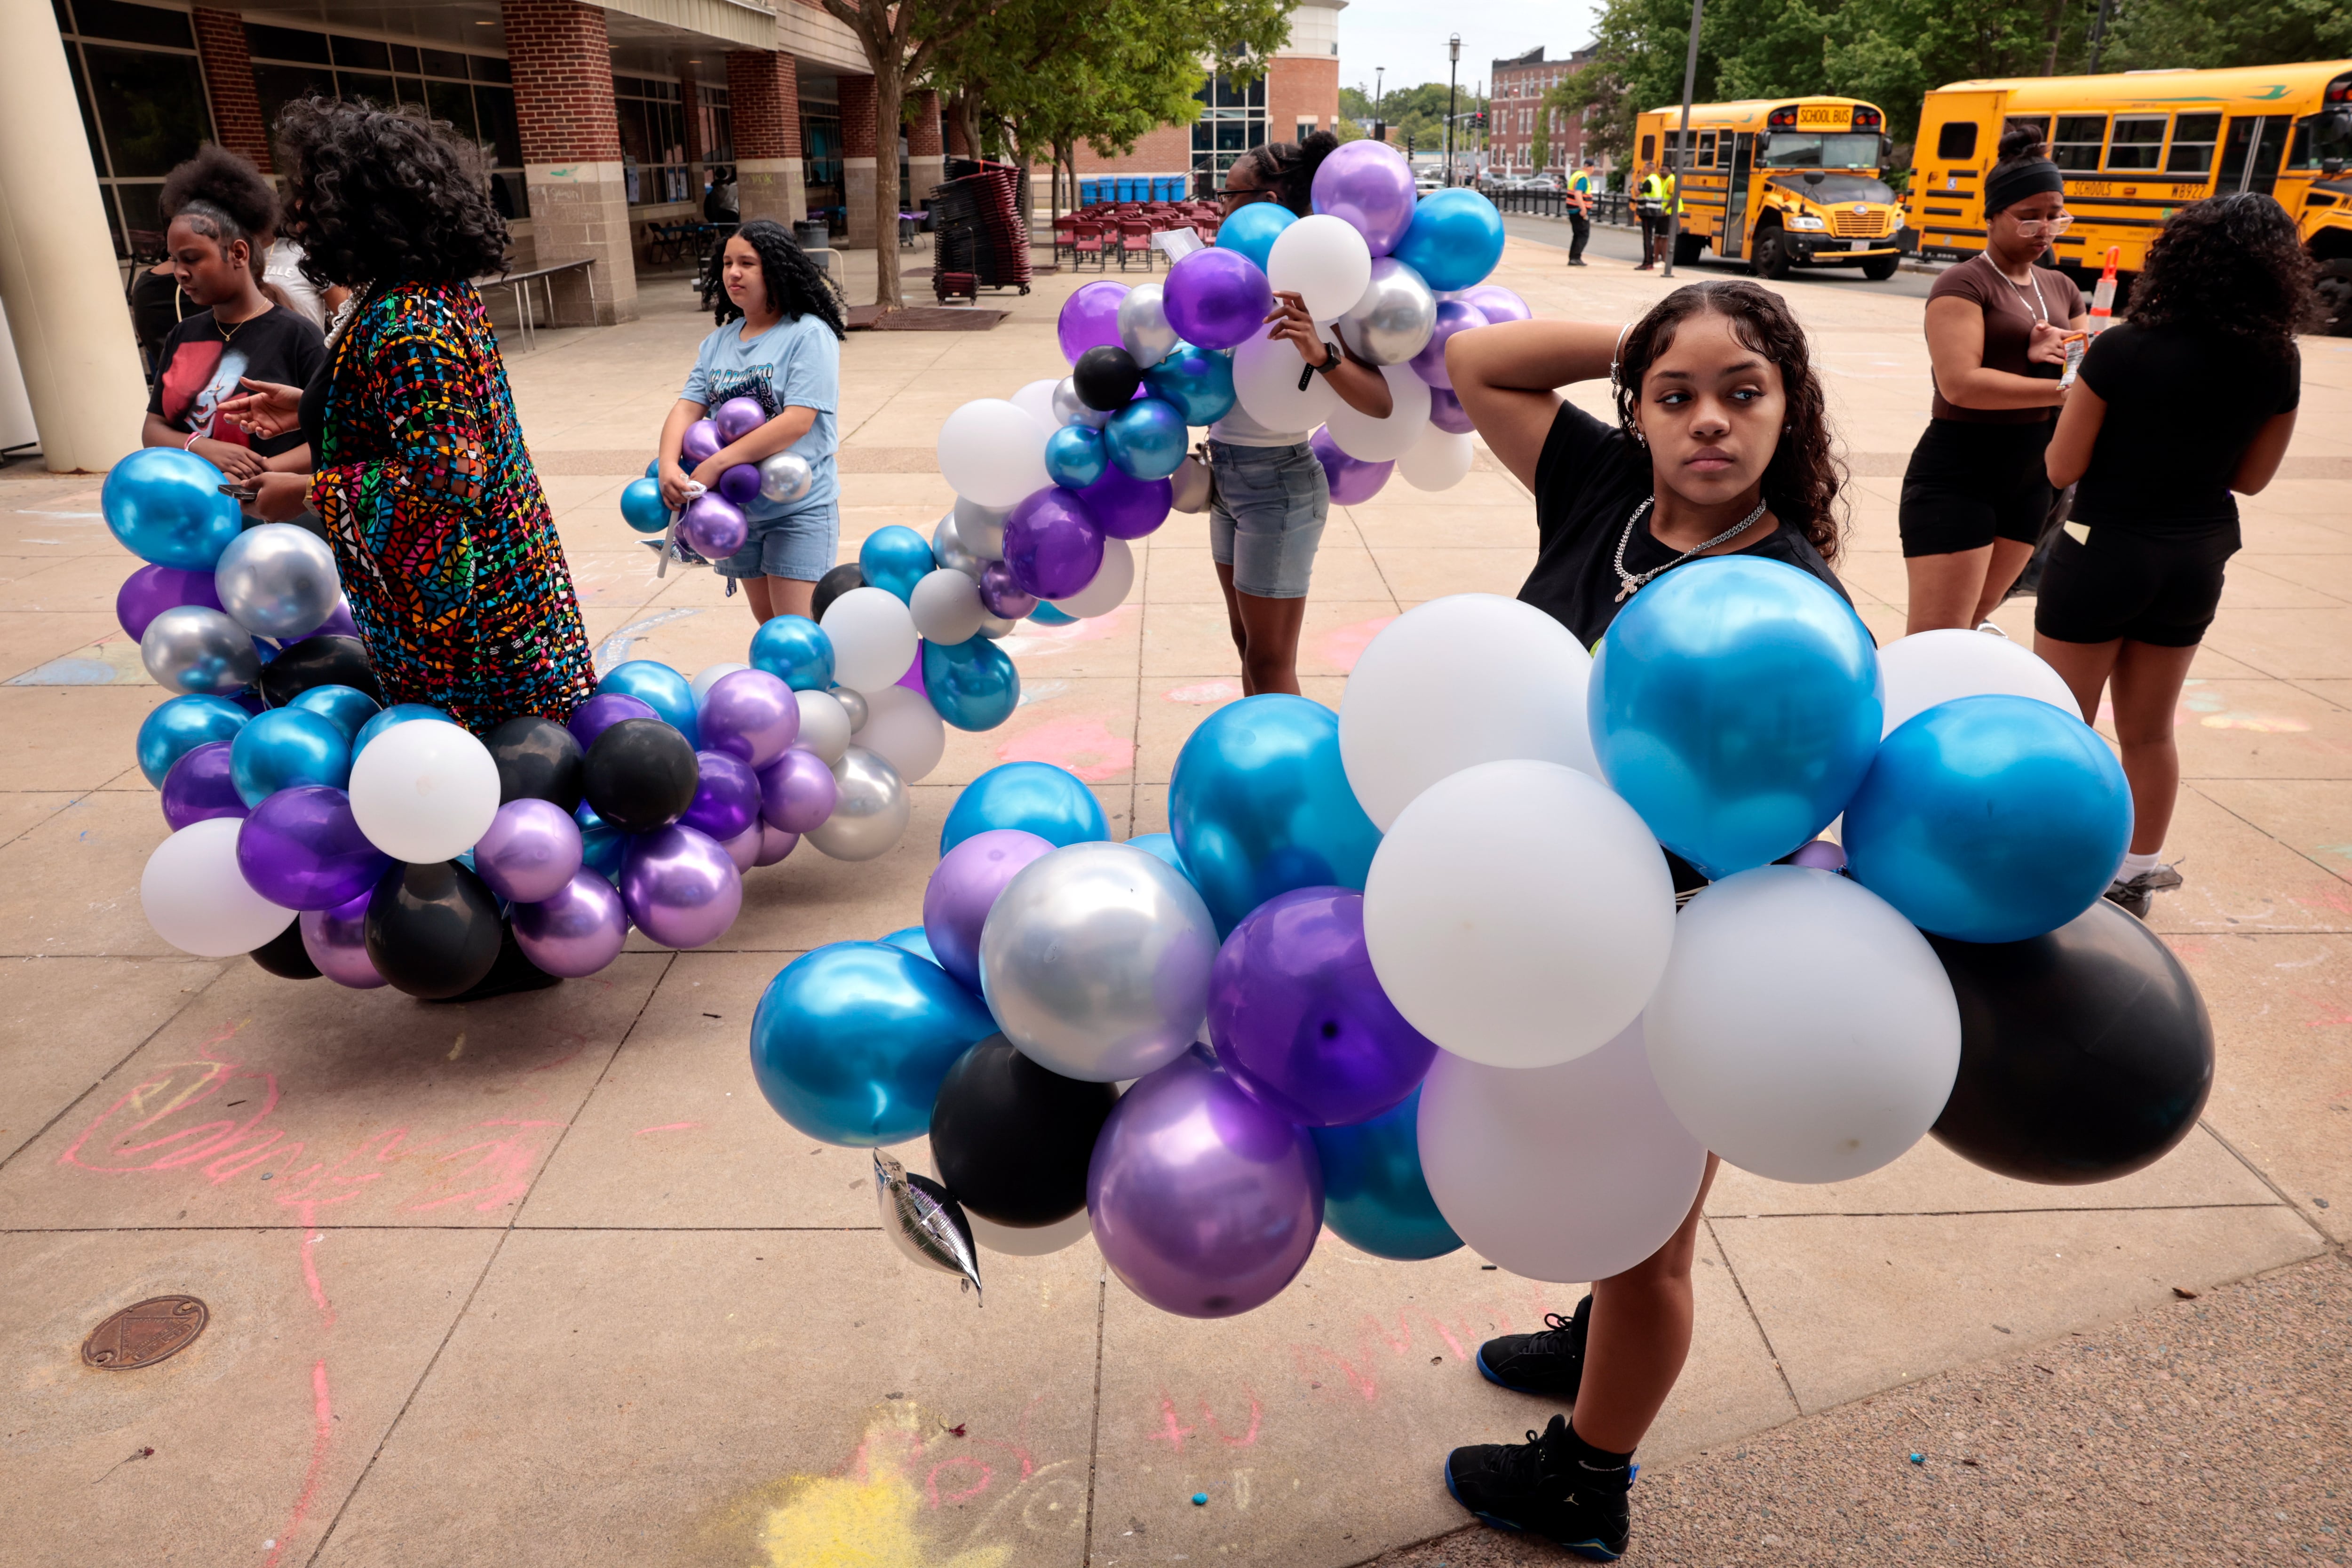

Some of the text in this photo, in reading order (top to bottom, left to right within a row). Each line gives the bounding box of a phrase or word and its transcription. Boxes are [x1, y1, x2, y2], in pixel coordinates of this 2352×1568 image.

[1800, 109, 1850, 123] SCHOOL BUS
[2073, 181, 2112, 197] SCHOOLS
